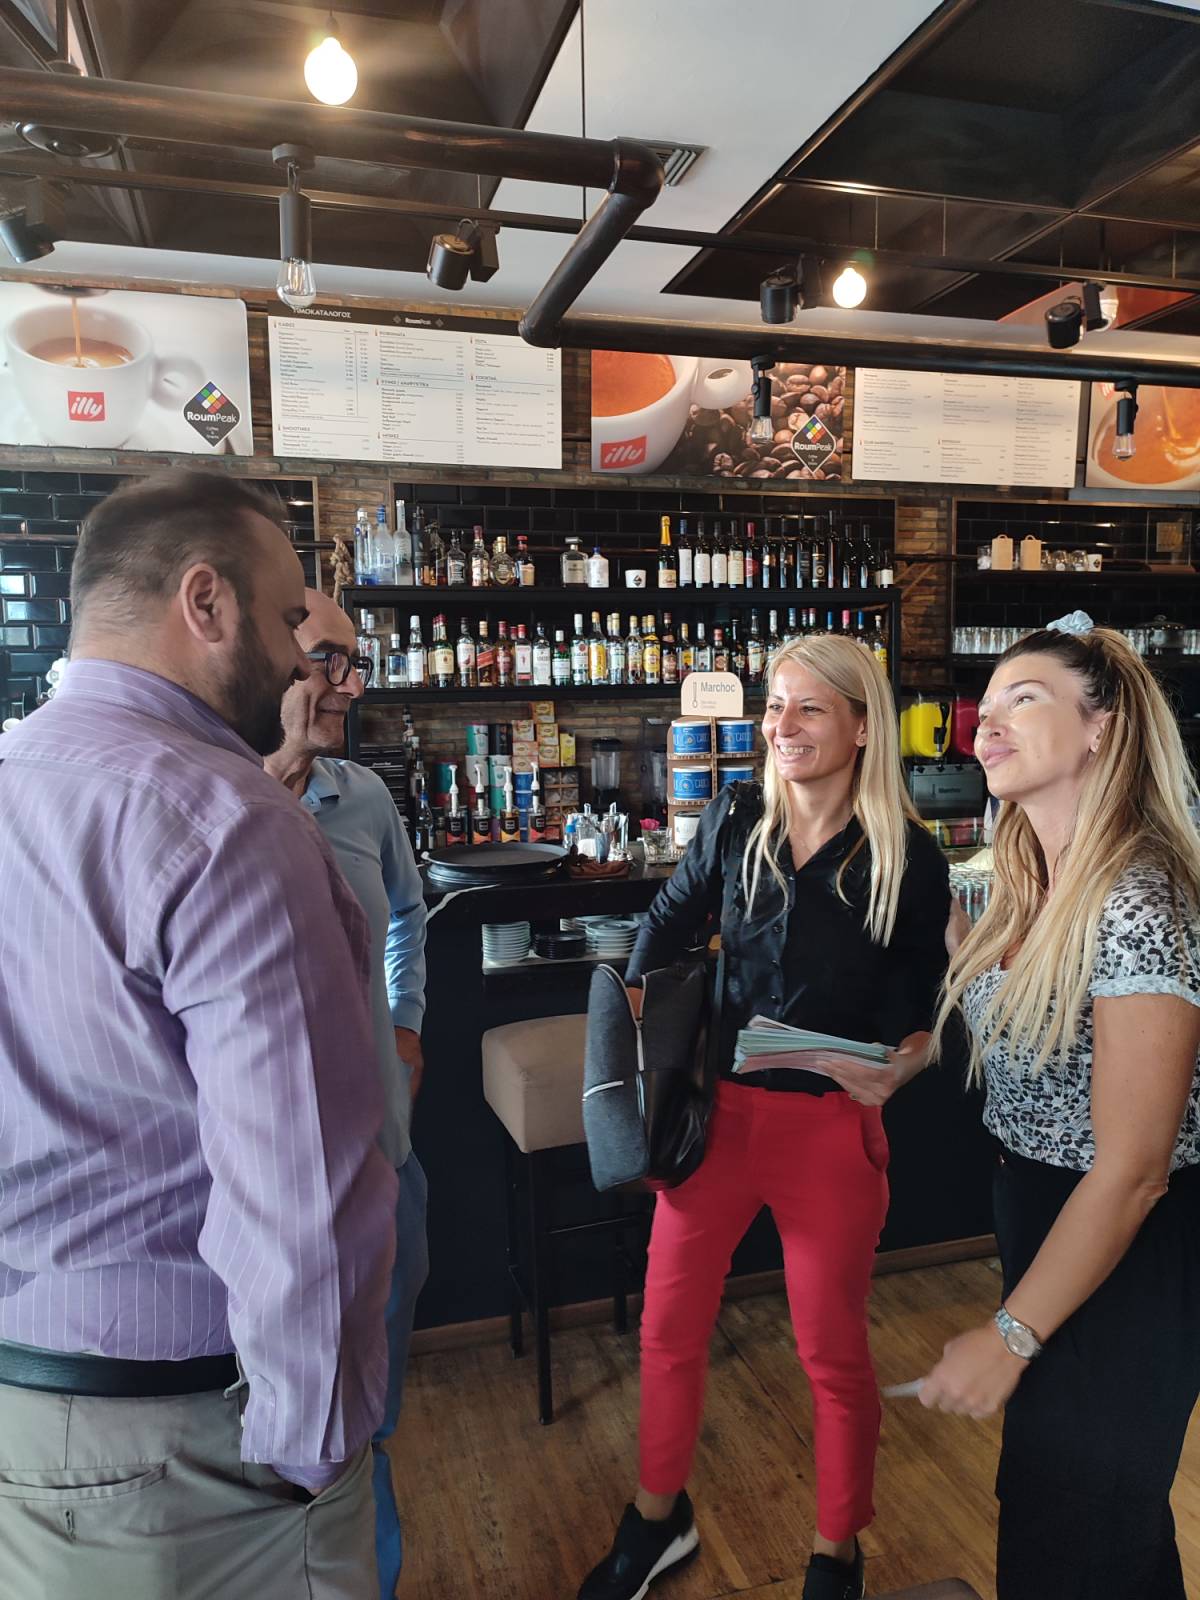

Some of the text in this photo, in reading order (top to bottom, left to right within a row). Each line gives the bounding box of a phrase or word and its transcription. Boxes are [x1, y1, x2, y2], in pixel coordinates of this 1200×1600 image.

[71, 397, 103, 416] illy
[186, 411, 237, 423] RoumPeak
[794, 442, 832, 451] RoumPeak
[604, 444, 644, 464] illy
[700, 681, 736, 692] Marchoc
